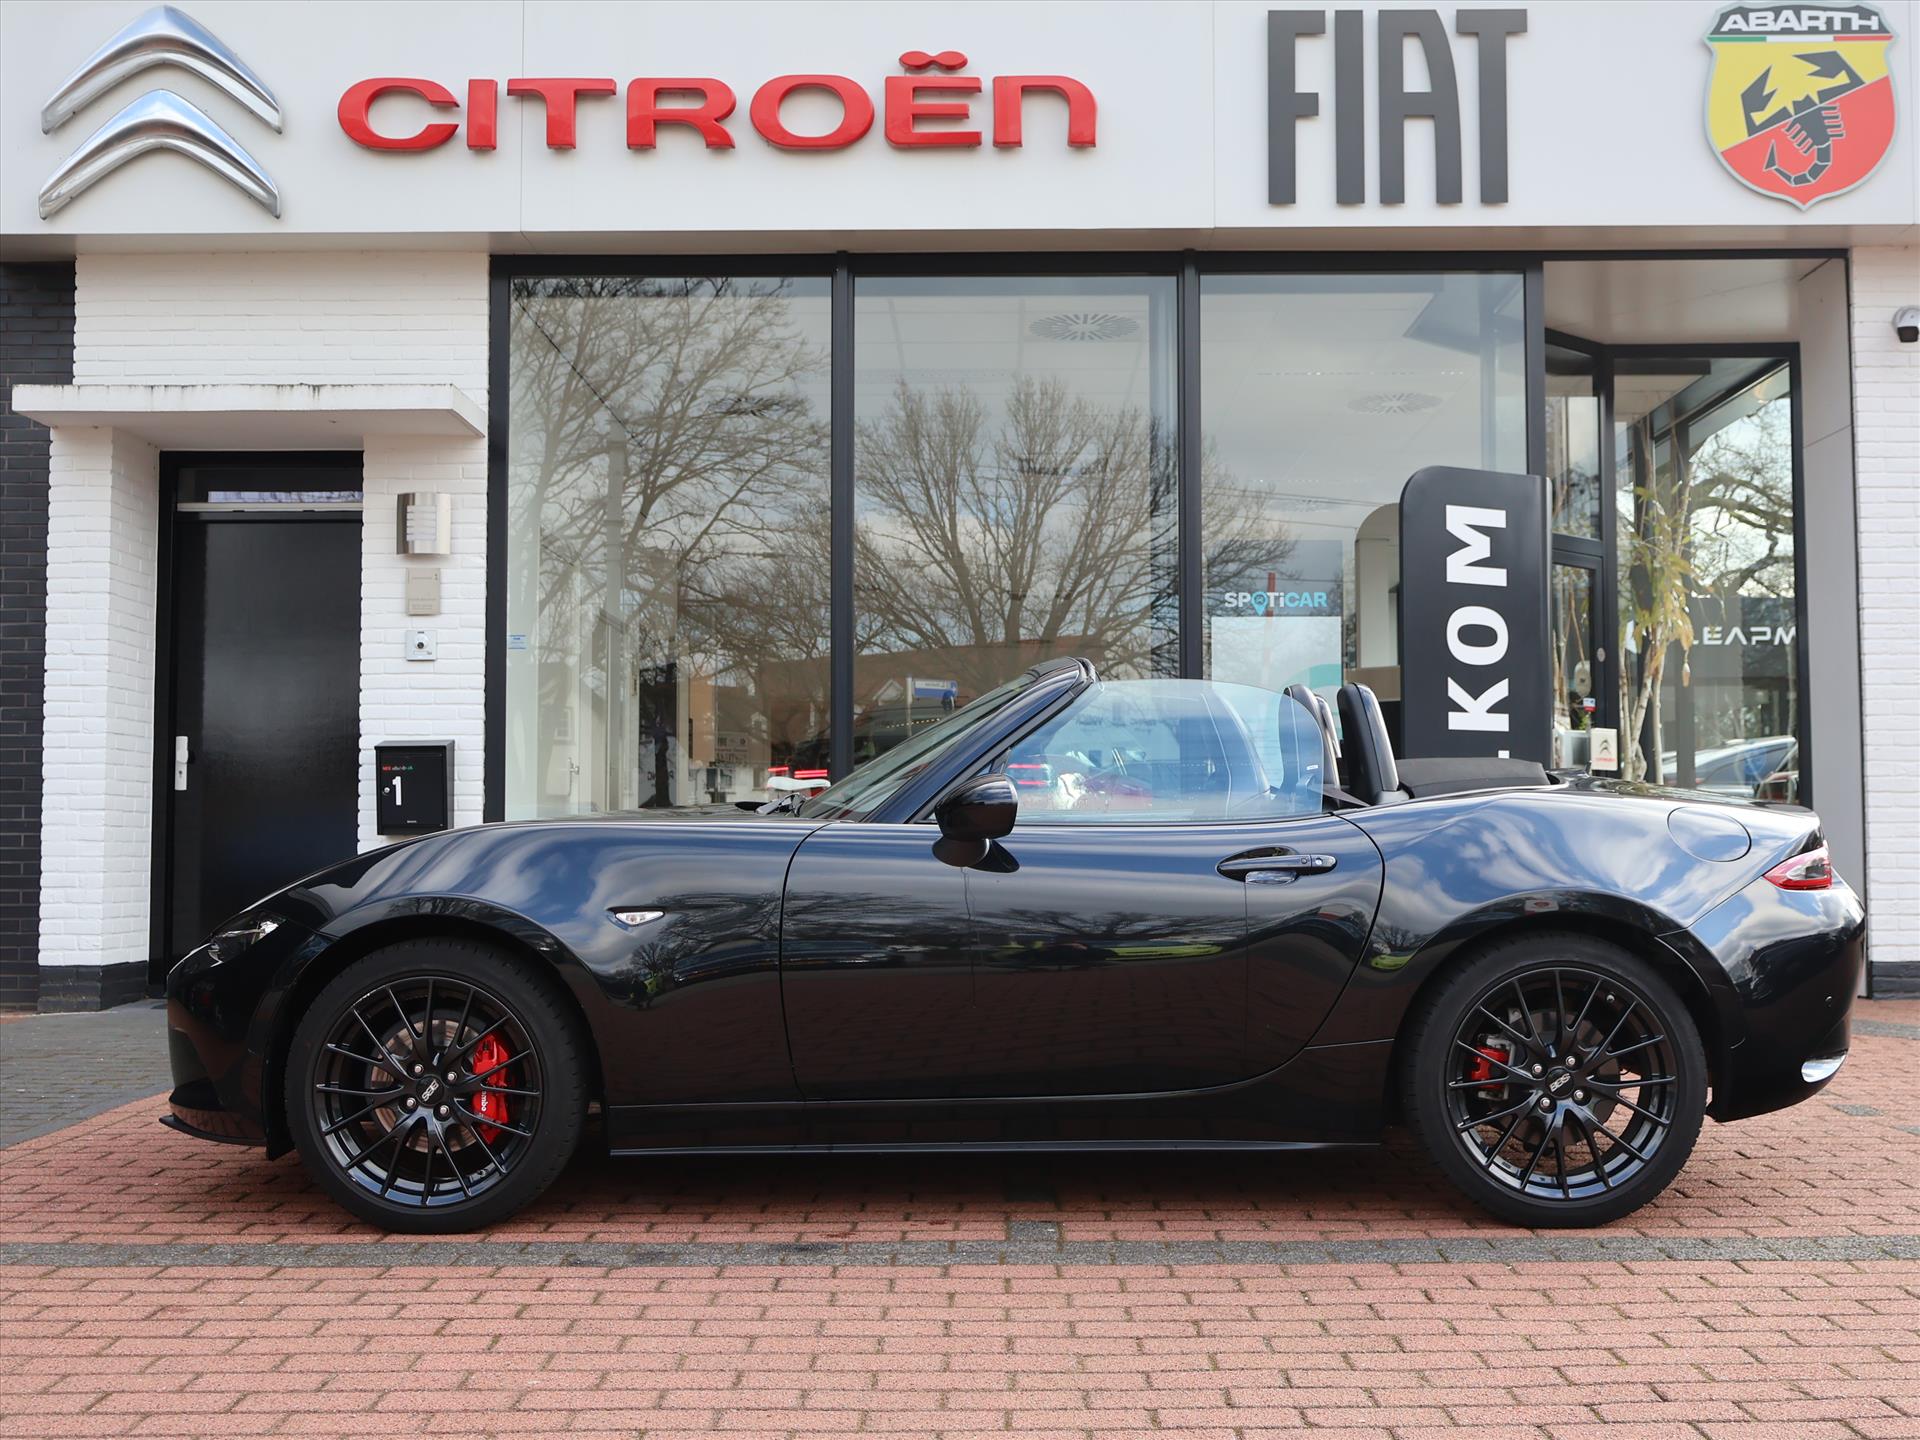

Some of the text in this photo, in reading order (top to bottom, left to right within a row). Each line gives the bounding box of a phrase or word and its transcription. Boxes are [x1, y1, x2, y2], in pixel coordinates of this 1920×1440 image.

[1720, 10, 1879, 31] ABARTH
[1268, 9, 1528, 204] FIAT
[1446, 504, 1510, 759] KOM
[1692, 626, 1796, 645] EAPM
[392, 776, 402, 806] 1
[421, 1079, 440, 1102] BBS
[1549, 1073, 1571, 1092] BBS
